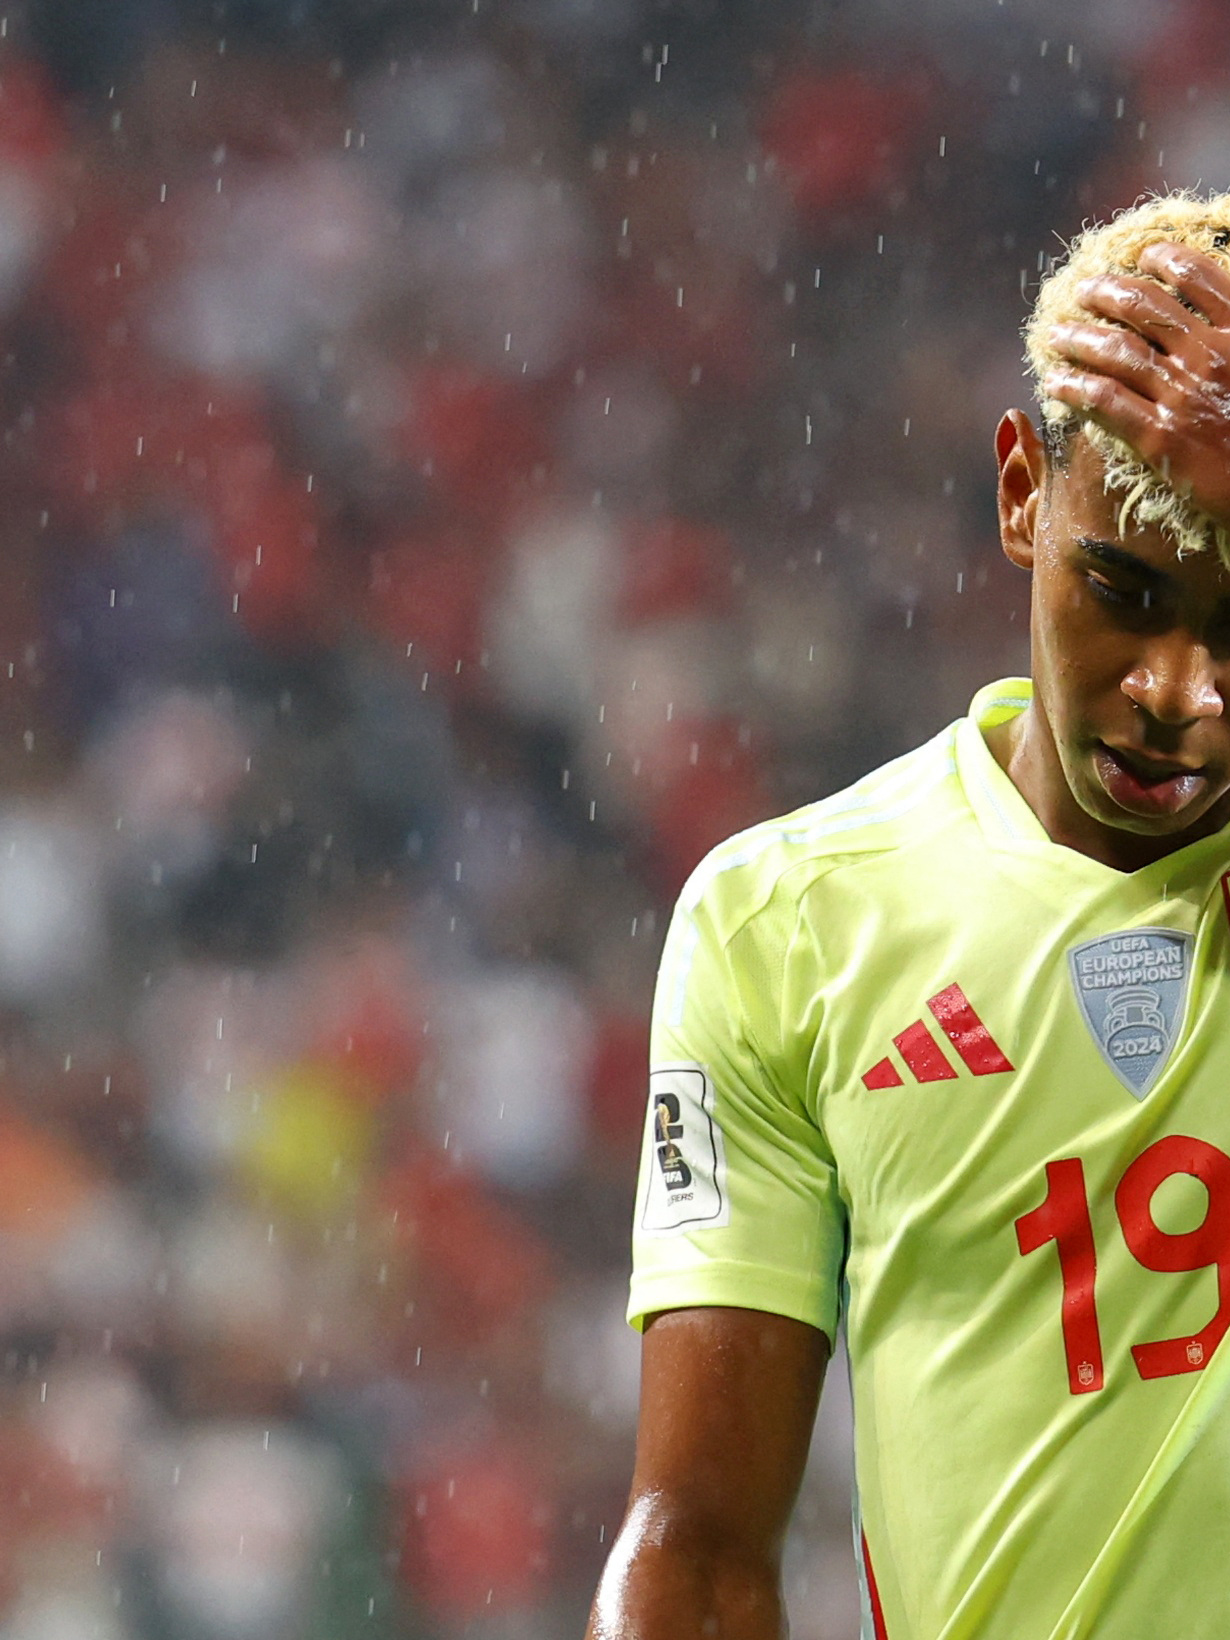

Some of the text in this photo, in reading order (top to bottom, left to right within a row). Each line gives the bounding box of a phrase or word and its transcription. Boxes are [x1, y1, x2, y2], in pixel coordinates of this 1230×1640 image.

[1111, 937, 1149, 953] UEFA
[1082, 946, 1182, 973] EUROPEAN
[1082, 965, 1183, 989] CHAMPIONS
[1112, 1035, 1162, 1057] 2024
